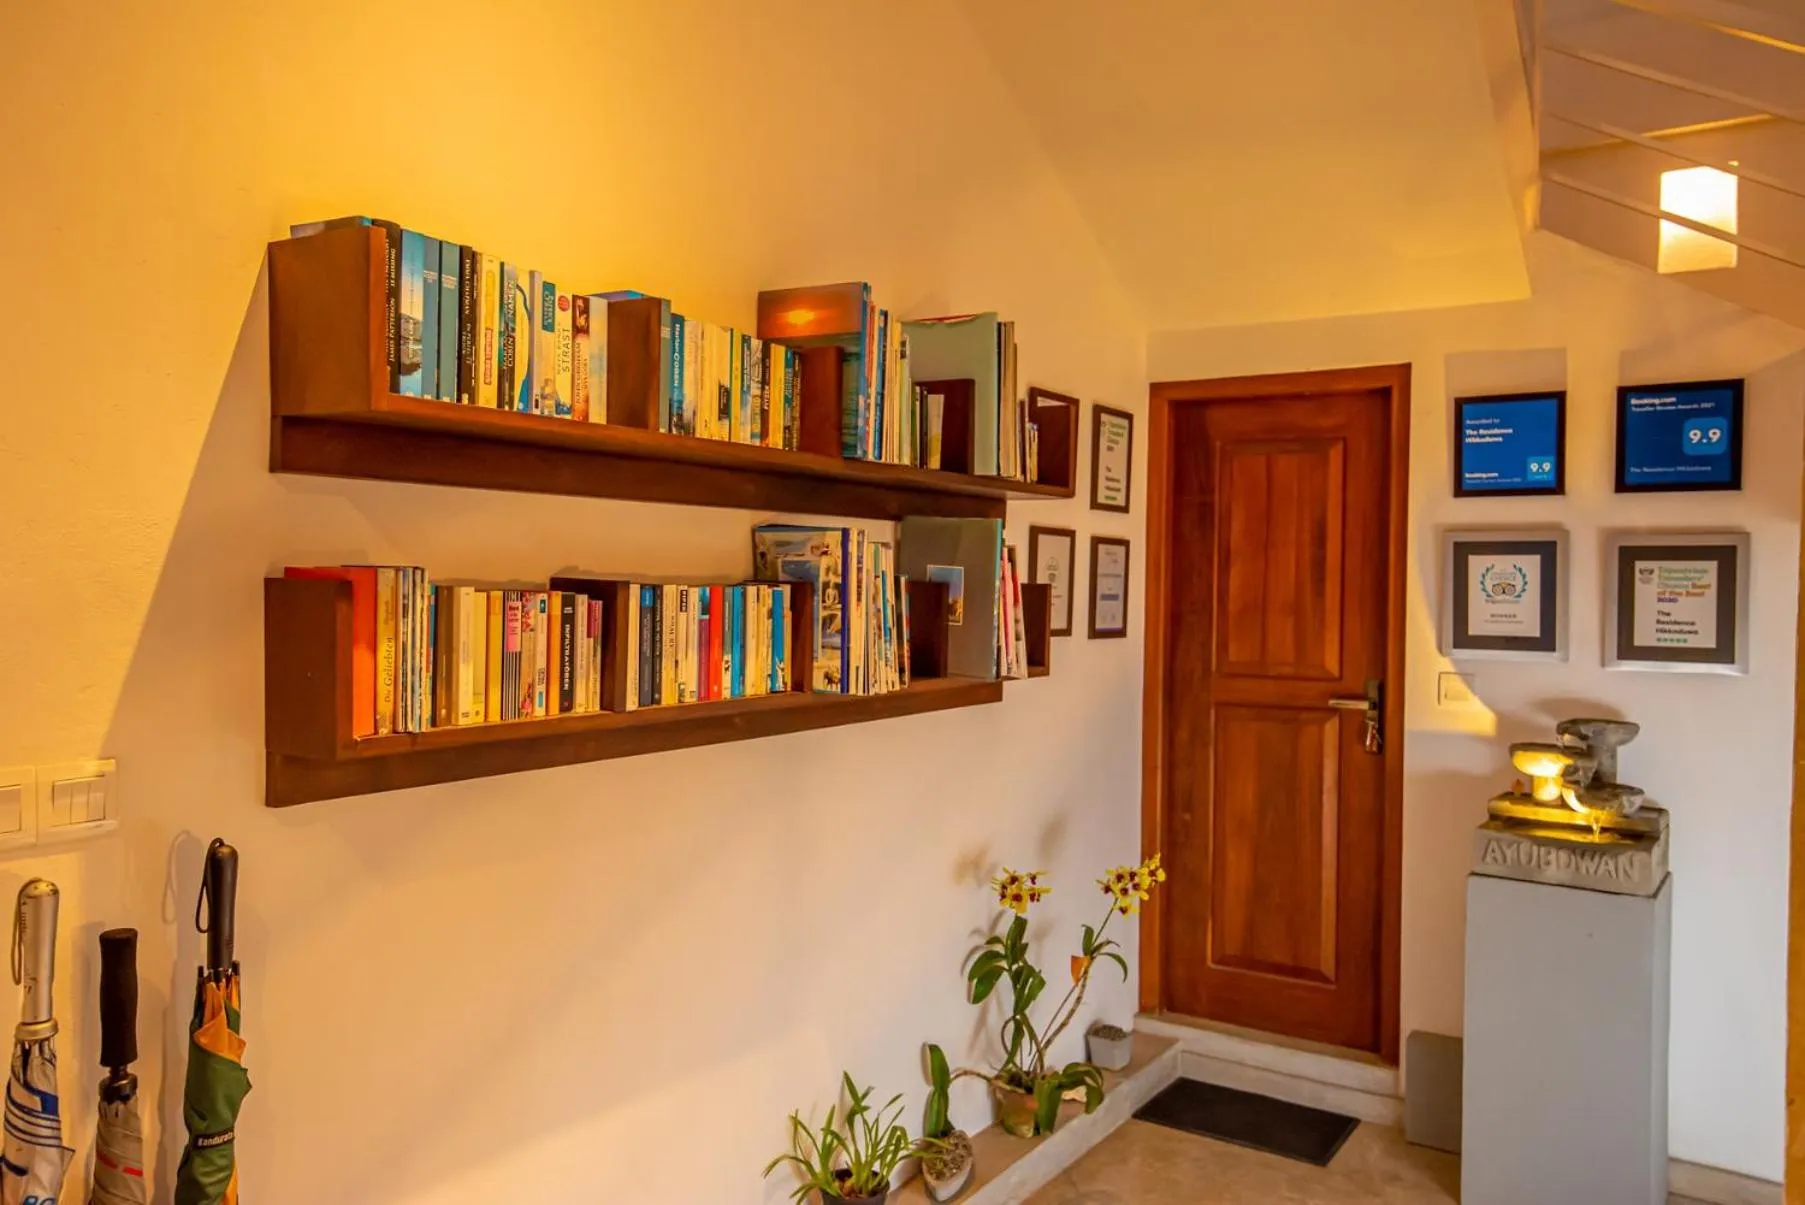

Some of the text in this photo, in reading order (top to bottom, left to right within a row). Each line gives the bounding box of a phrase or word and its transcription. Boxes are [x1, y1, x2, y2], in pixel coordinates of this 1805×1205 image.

[561, 327, 570, 373] STRAST
[1630, 396, 1677, 405] Booking.com
[1465, 428, 1478, 436] The
[1688, 427, 1721, 444] 9.9
[1529, 461, 1551, 473] 9.9
[383, 637, 393, 687] Geliebten
